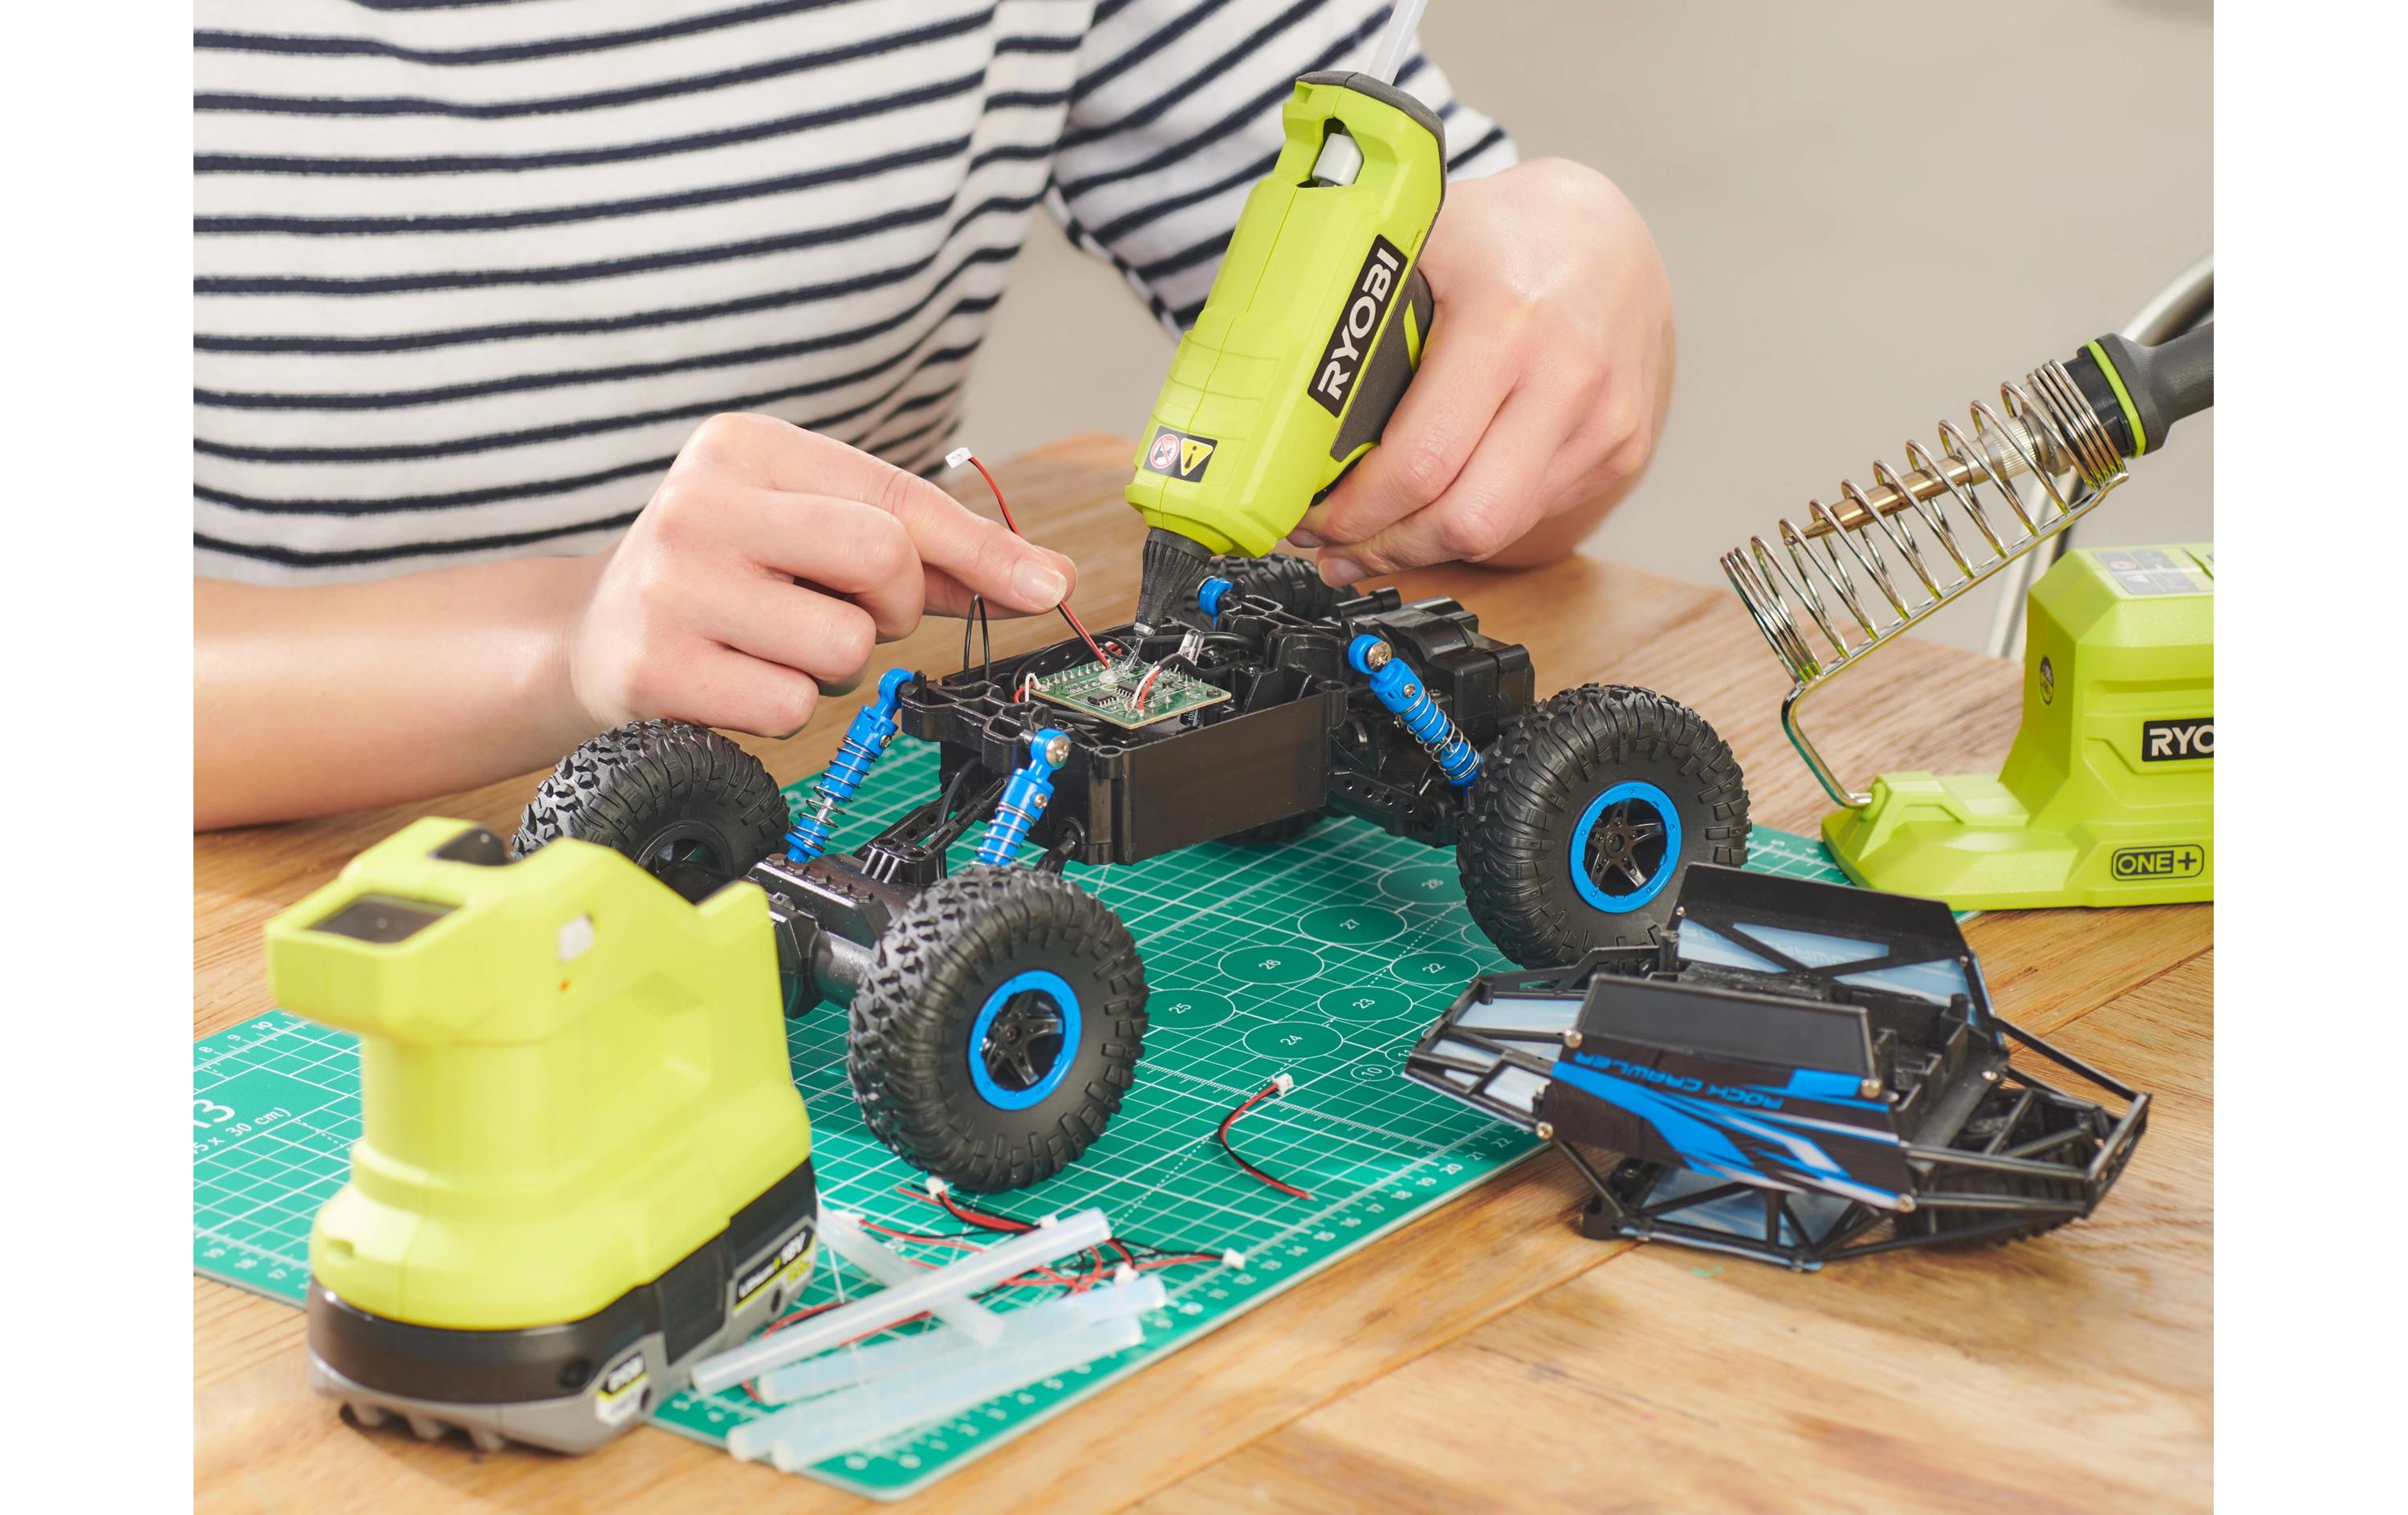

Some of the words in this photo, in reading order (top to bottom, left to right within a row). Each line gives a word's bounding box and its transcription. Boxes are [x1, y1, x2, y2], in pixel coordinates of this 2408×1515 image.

[1317, 247, 1400, 400] RYOBI
[2117, 851, 2197, 874] ONE+
[1340, 919, 1361, 930] 27
[1259, 959, 1282, 970] 26
[1422, 963, 1446, 974] 22
[1168, 1003, 1192, 1014] 25
[1352, 998, 1375, 1009] 23
[198, 1046, 214, 1054] 8
[226, 1034, 242, 1042] 9
[250, 1021, 274, 1030] 10
[1279, 1034, 1304, 1046] 24
[1361, 1066, 1383, 1077] 10
[1573, 1051, 1704, 1092] CRAWLER
[1707, 1084, 1784, 1111] ROCK
[193, 1099, 235, 1129] 3
[226, 1123, 252, 1137] 30
[254, 1107, 292, 1125] cm)
[1365, 1203, 1385, 1213] 17
[1390, 1190, 1413, 1200] 18
[1415, 1176, 1438, 1187] 19
[1439, 1163, 1464, 1176] 20
[1465, 1151, 1487, 1161] 21
[1491, 1137, 1514, 1149] 22
